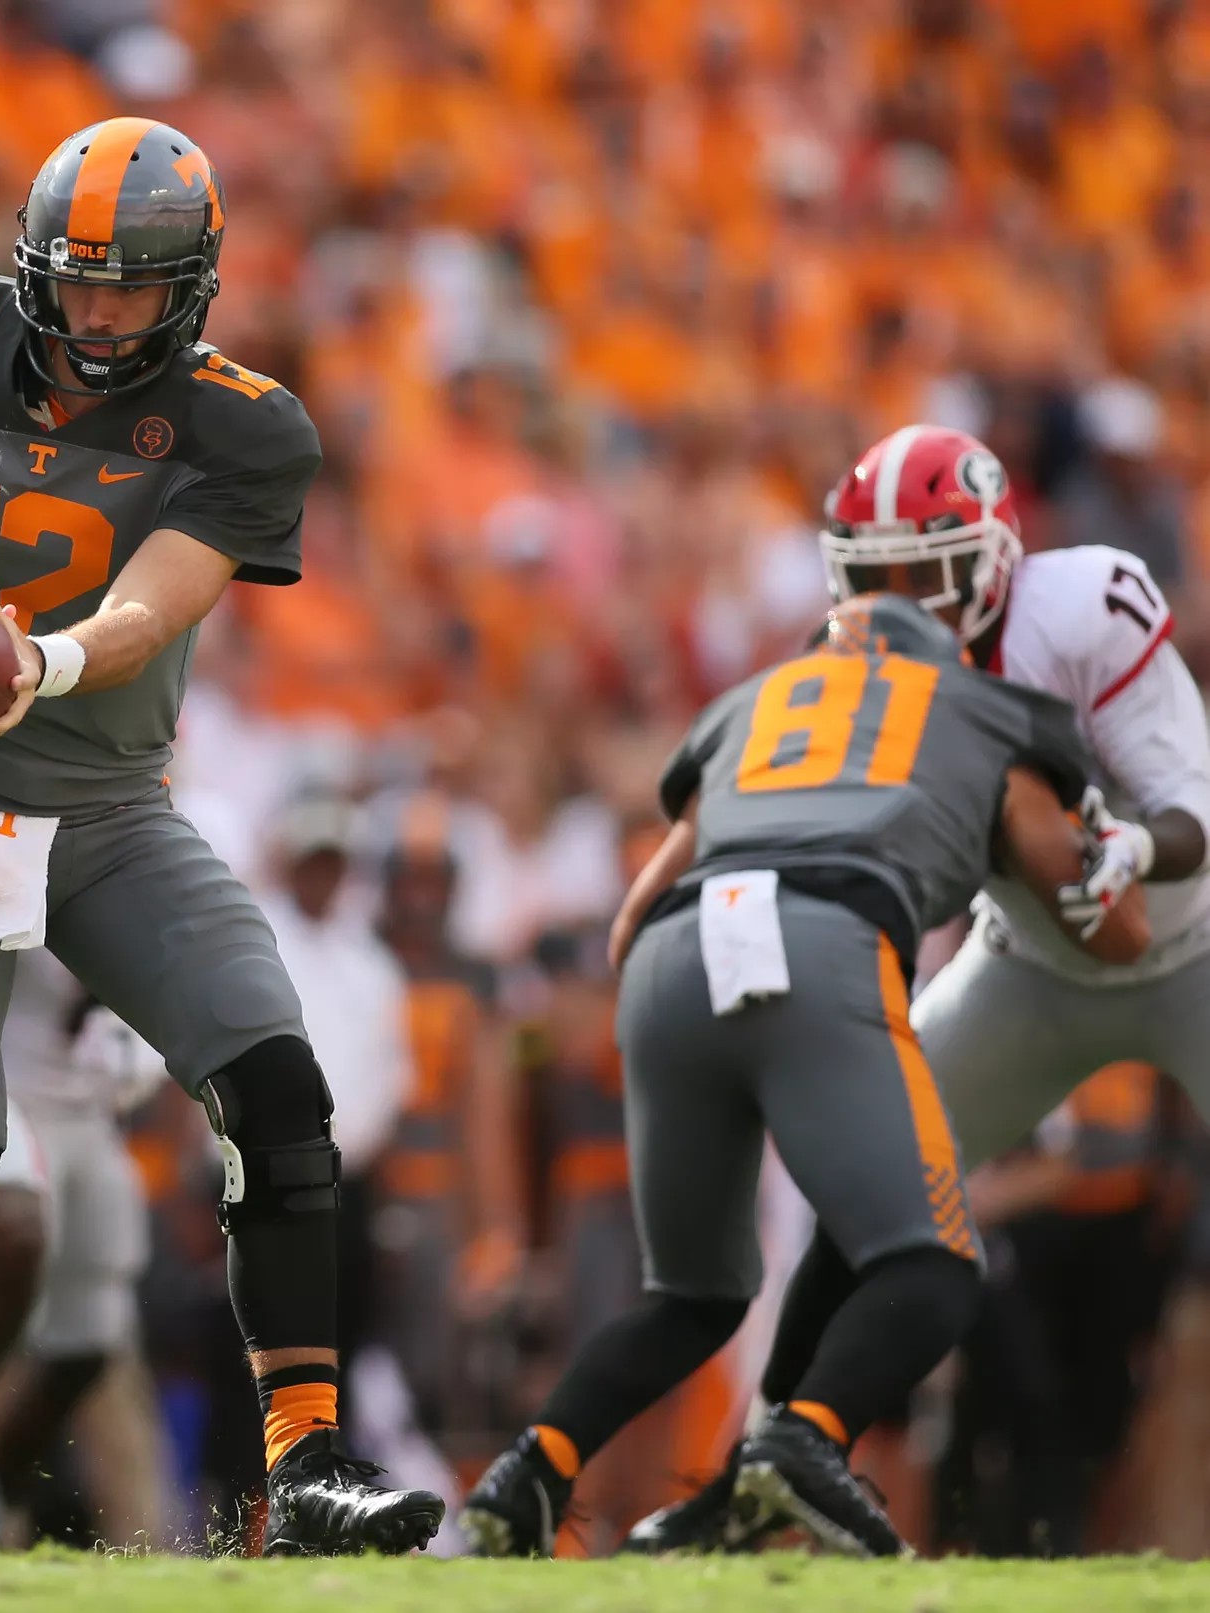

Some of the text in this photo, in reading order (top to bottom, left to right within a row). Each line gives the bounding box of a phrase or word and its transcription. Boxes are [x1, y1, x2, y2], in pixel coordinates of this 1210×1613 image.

[69, 242, 107, 260] VOLS
[27, 442, 58, 475] T
[1105, 566, 1157, 634] 17
[737, 652, 940, 793] 81
